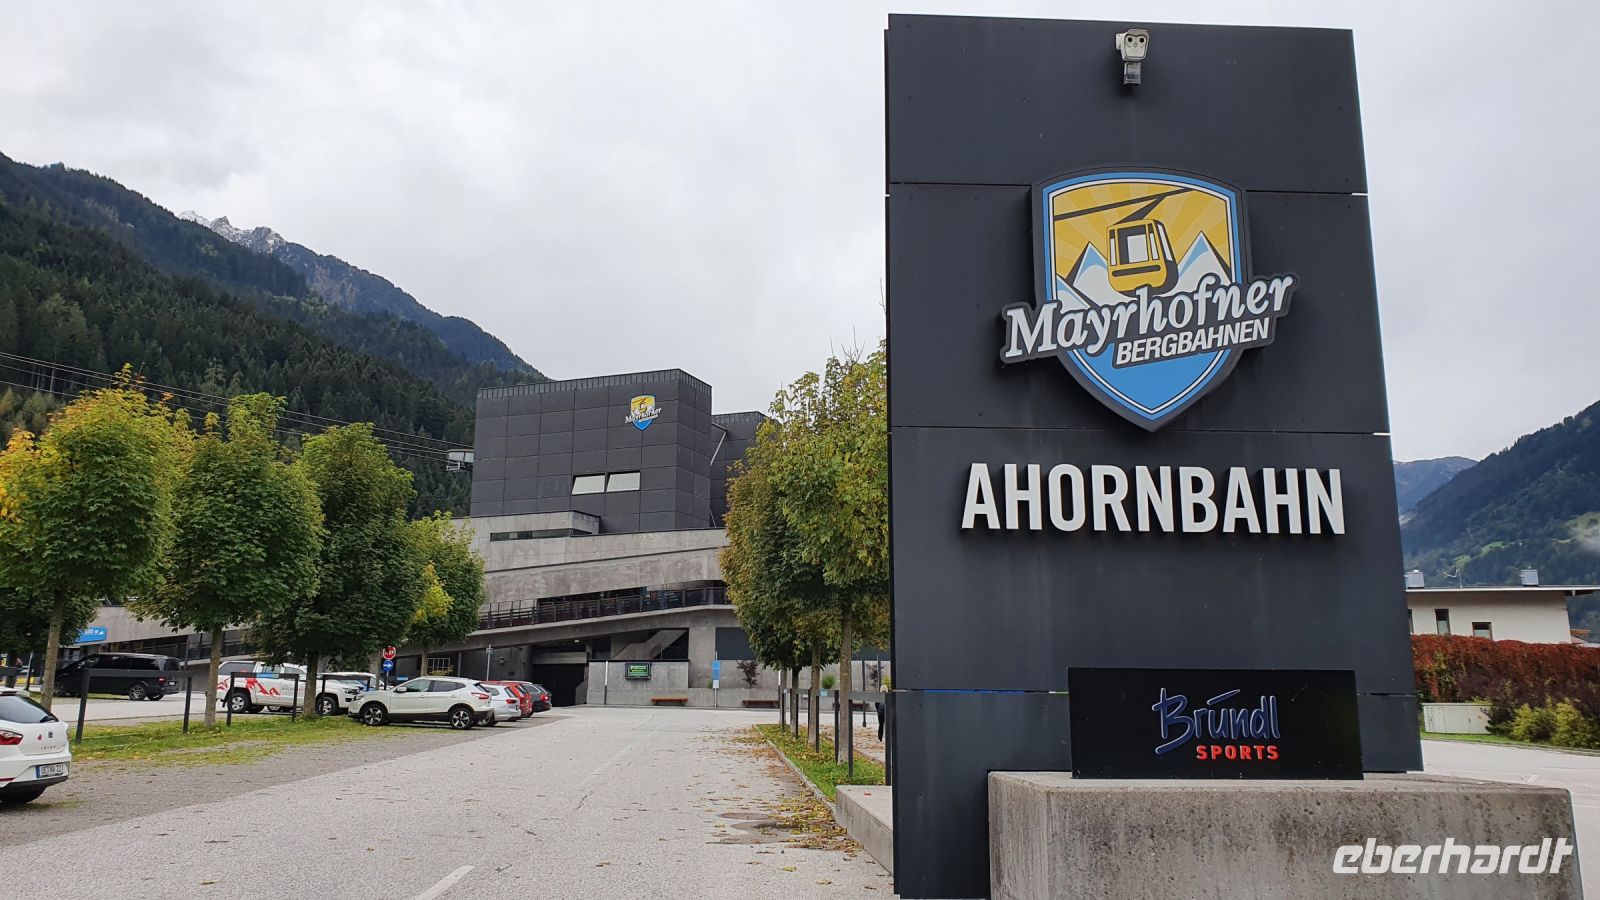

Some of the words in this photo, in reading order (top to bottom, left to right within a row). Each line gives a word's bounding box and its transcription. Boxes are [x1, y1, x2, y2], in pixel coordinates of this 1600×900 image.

[1005, 274, 1292, 358] Mayrhofner
[1116, 317, 1269, 365] BERGBAHNEN
[961, 462, 1345, 534] AHORNBAHN
[1196, 745, 1279, 760] SPORTS
